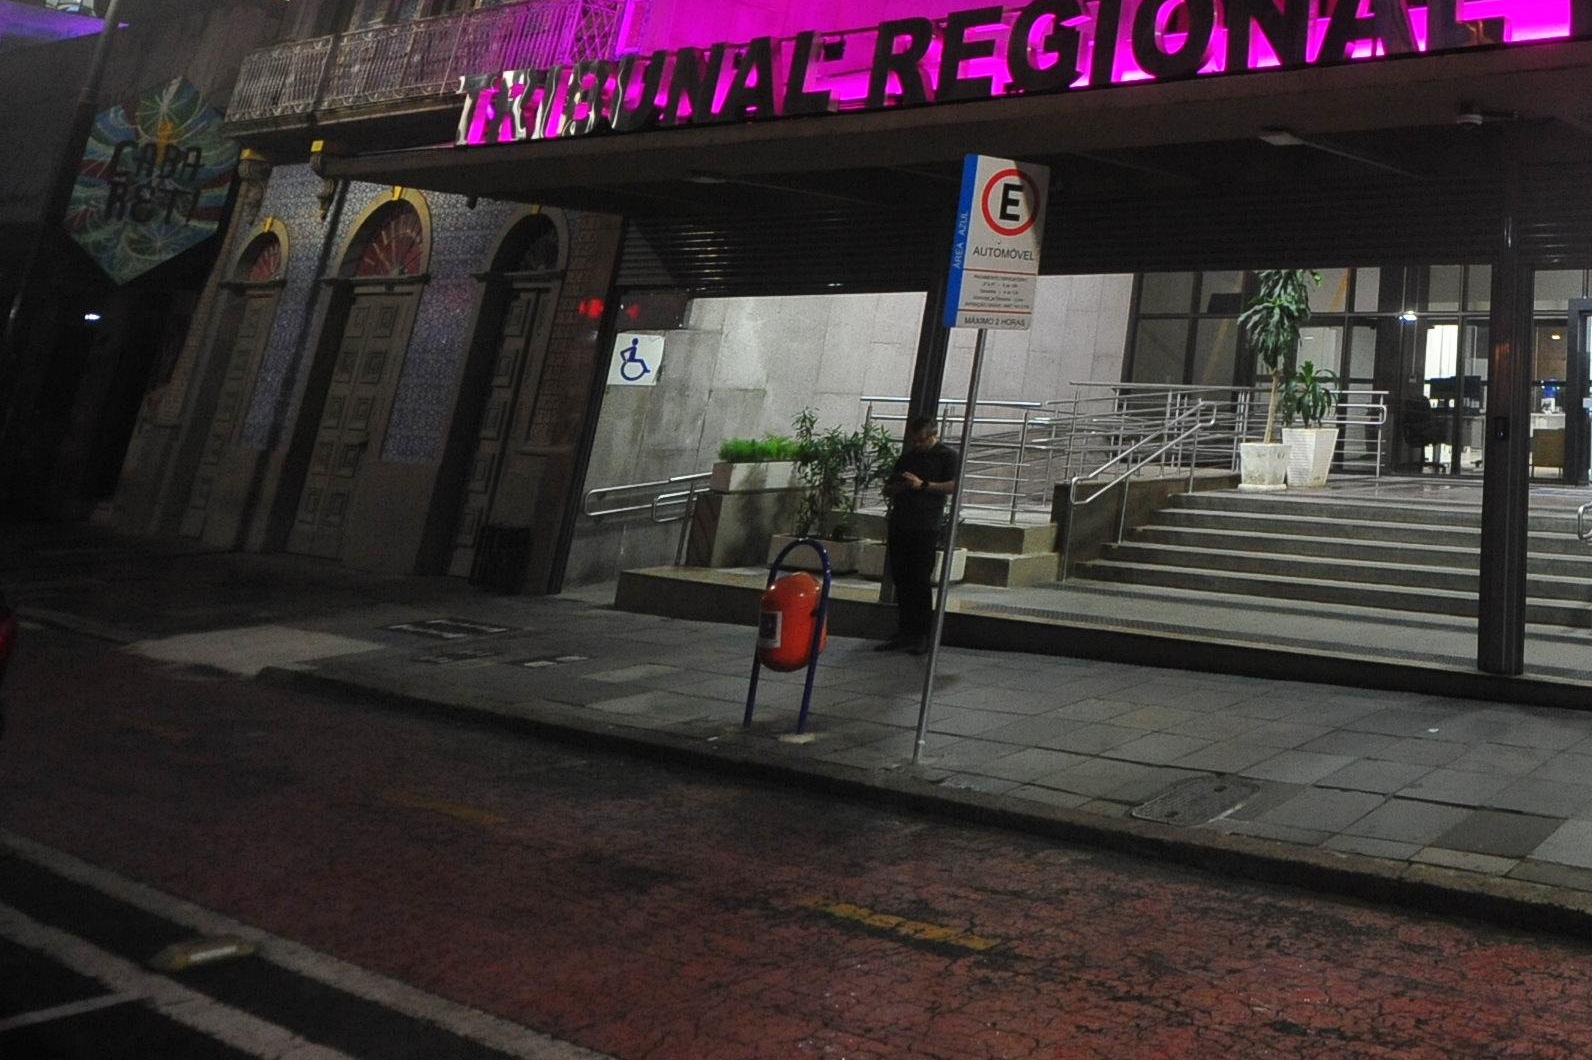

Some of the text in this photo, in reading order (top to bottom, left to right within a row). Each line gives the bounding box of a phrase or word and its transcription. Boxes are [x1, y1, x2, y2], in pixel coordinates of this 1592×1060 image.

[455, 30, 840, 146] TRIBUNAL
[999, 182, 1025, 222] E
[972, 245, 1036, 261] AUTOMÓVEL
